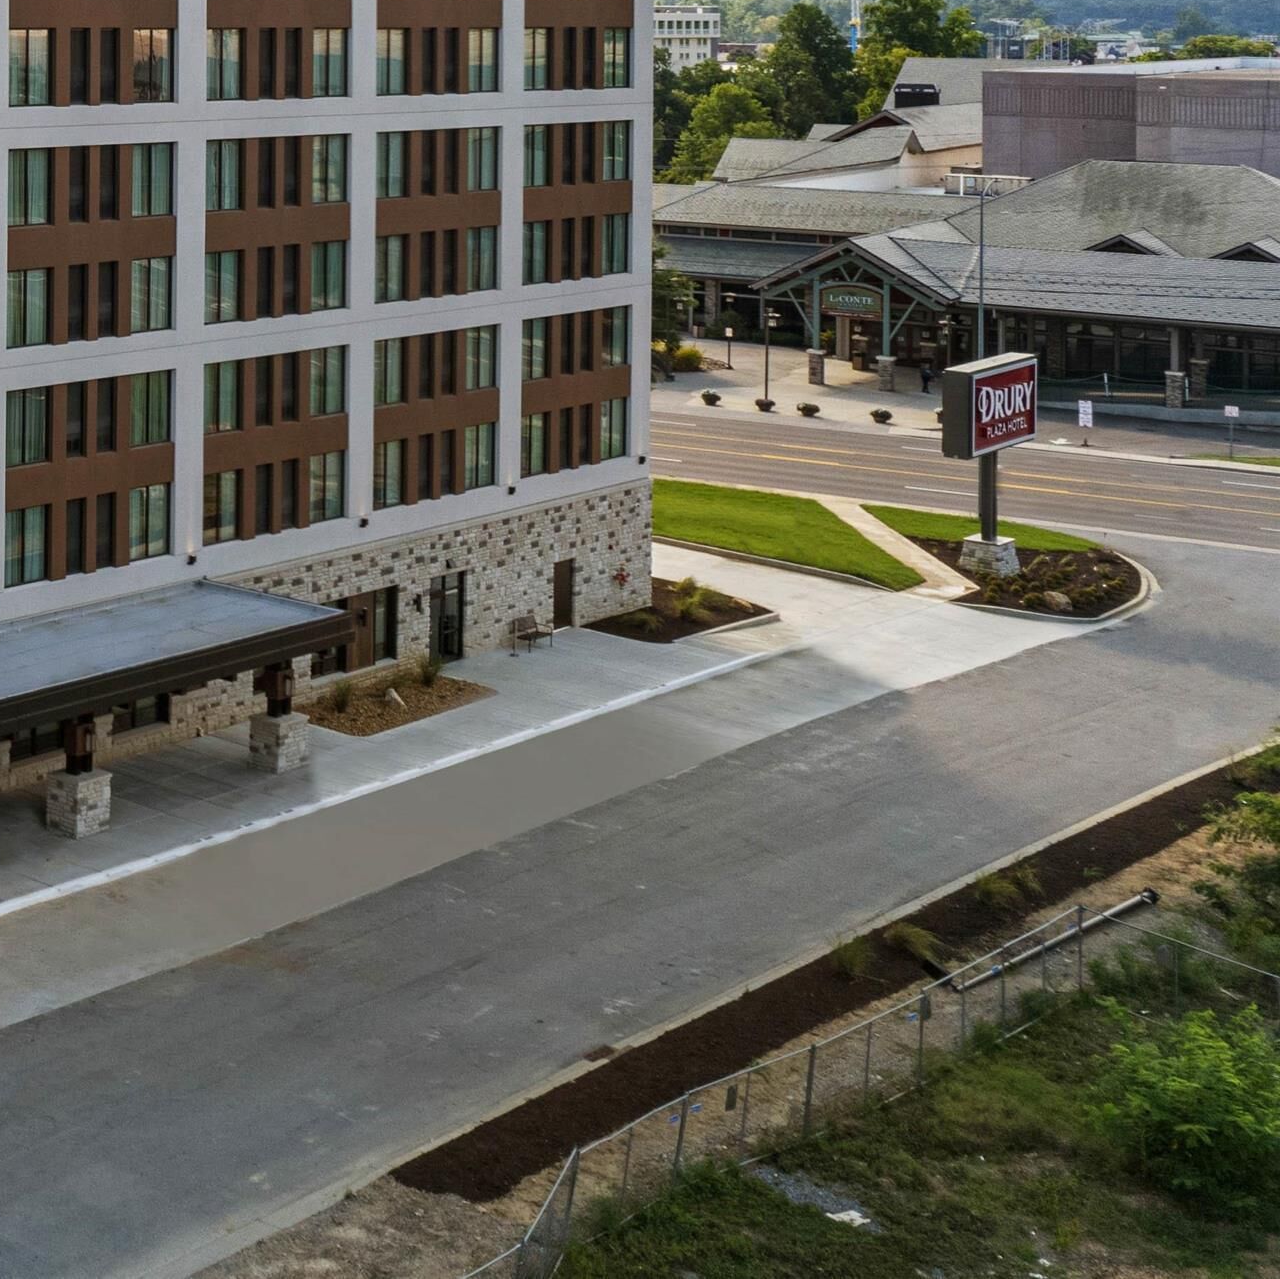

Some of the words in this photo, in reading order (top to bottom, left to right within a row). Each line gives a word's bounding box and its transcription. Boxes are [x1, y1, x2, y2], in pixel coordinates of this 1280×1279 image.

[978, 381, 1033, 423] DRURY
[987, 423, 1007, 438] PLAZA
[1008, 417, 1027, 431] HOTEL
